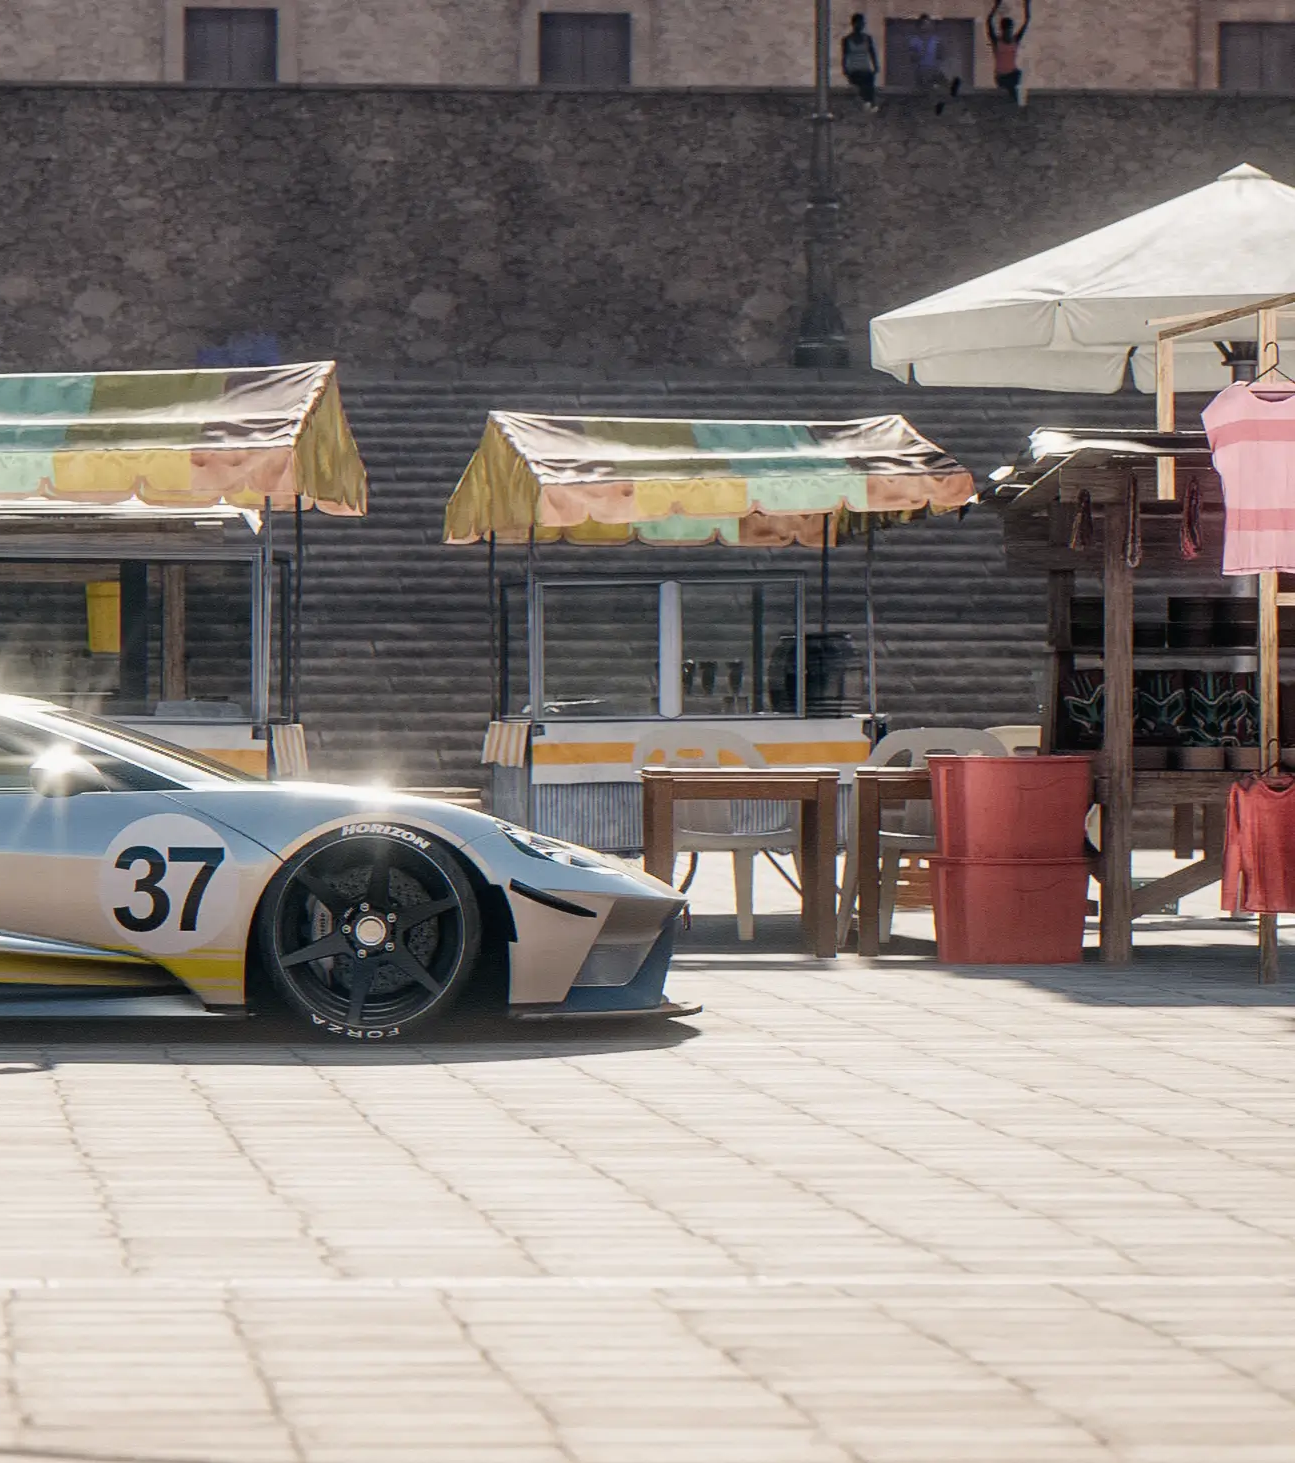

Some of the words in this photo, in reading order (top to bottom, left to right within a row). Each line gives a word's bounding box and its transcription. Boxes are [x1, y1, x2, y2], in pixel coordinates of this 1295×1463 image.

[341, 822, 432, 850] HORIZON
[113, 845, 225, 932] 37
[311, 1013, 401, 1039] FORZA
